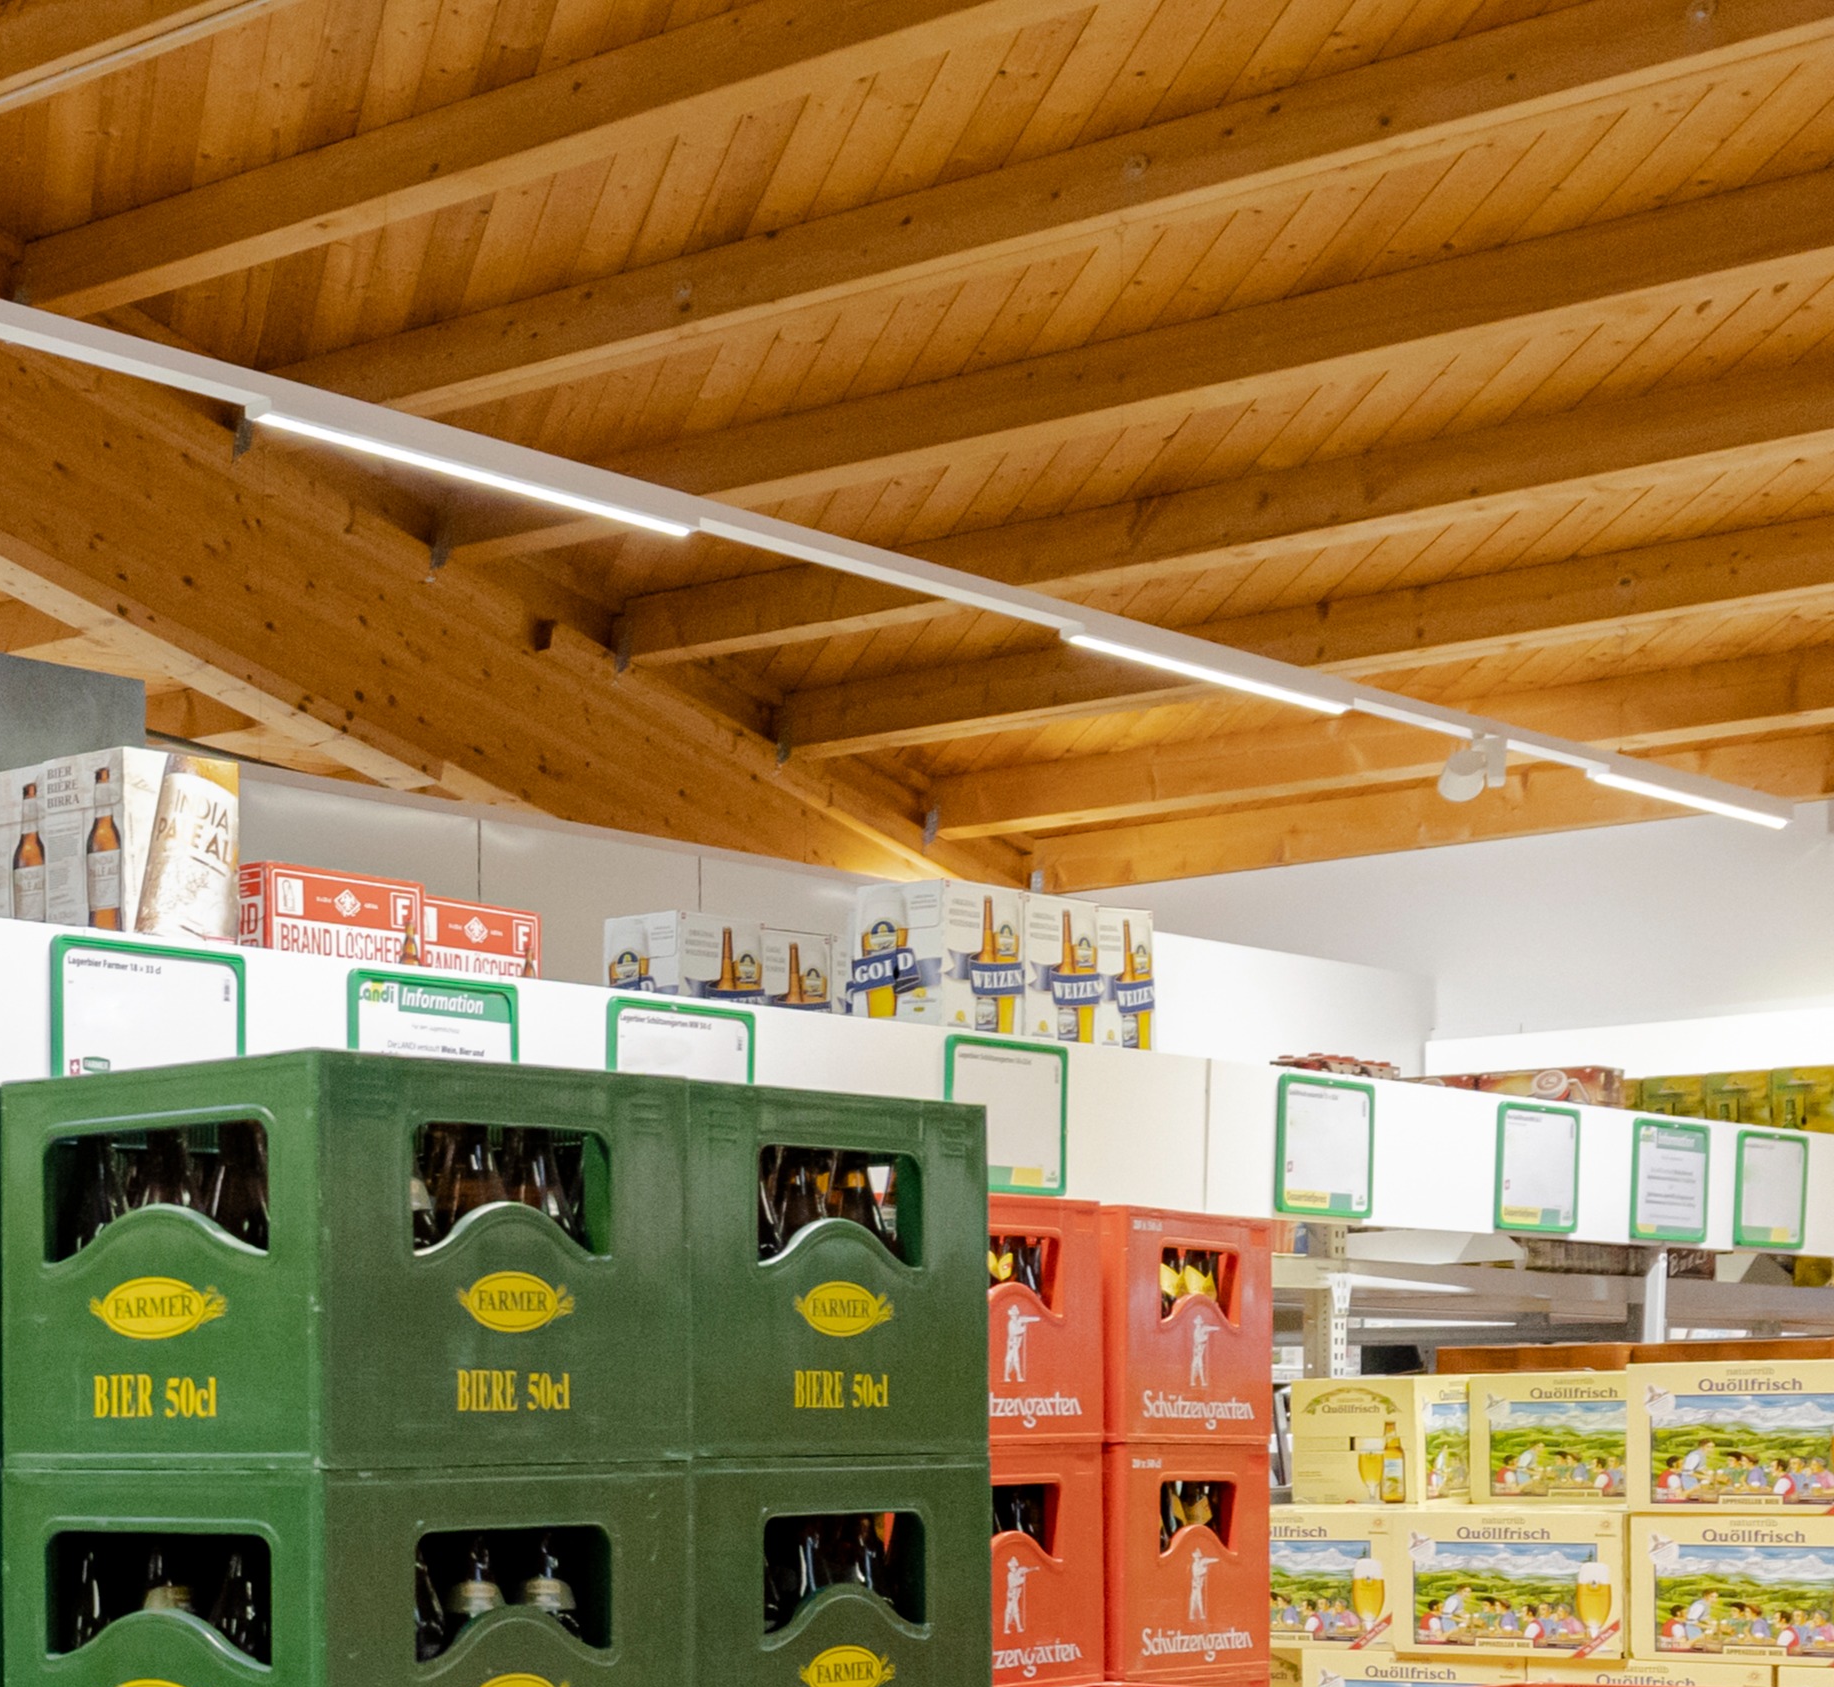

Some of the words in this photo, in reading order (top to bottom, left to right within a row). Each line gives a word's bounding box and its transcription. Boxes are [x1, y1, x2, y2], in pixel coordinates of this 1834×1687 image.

[47, 766, 72, 779] BIER
[47, 778, 78, 794] BIÈRE
[47, 795, 80, 808] BIRRA
[176, 789, 229, 830] INDIA
[396, 897, 410, 926] F
[972, 968, 1024, 990] WEIZEN
[402, 987, 483, 1015] Information
[1053, 980, 1101, 1001] WEIZEN
[1117, 986, 1154, 1008] WEIZEN
[473, 1286, 553, 1317] FARMER
[456, 1369, 518, 1412] BIERE
[526, 1371, 571, 1412] 50cl
[1529, 1386, 1619, 1401] Quöllfrisch
[1697, 1377, 1804, 1393] Quöllfrisch
[1142, 1390, 1254, 1430] Schützengarten
[1321, 1403, 1380, 1415] Quöllfrisch
[1456, 1525, 1551, 1541] Quöllfrisch
[1702, 1528, 1806, 1544] Quöllfrisch
[1142, 1627, 1253, 1663] Schützengarten
[812, 1657, 879, 1687] FARMER
[1365, 1665, 1456, 1681] Quöllfrisch
